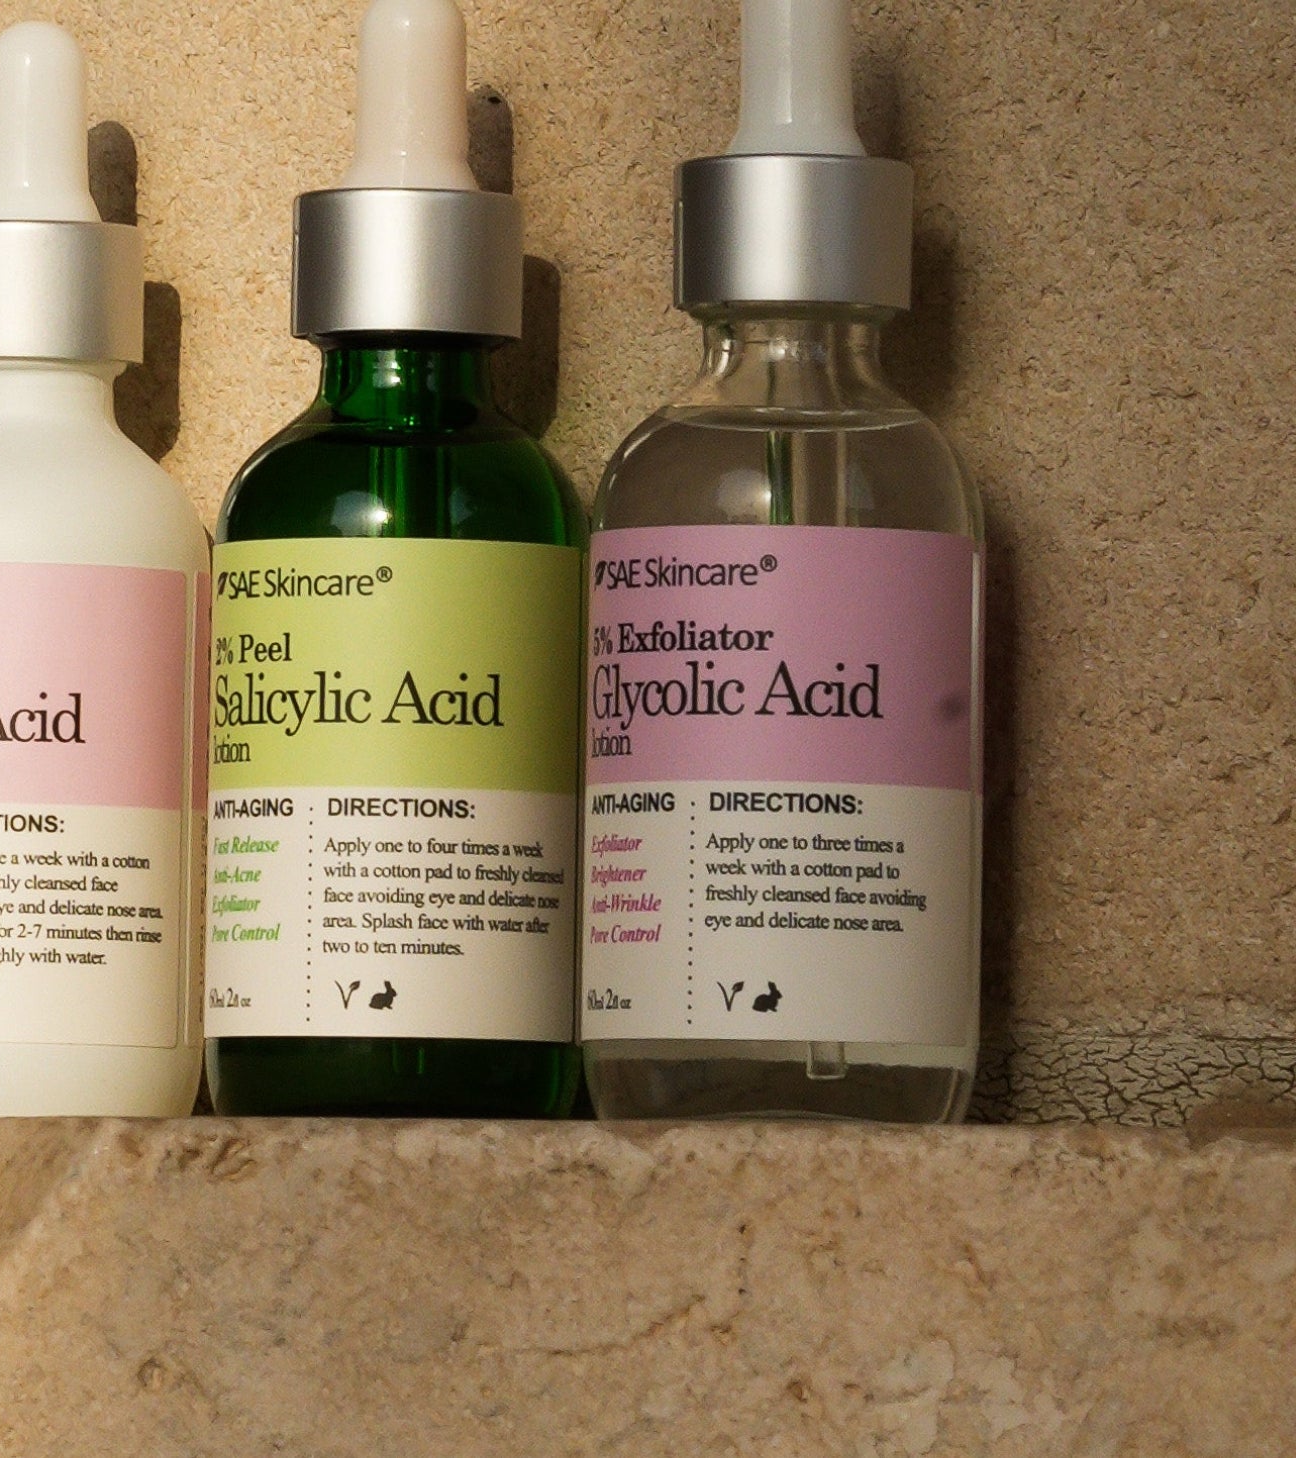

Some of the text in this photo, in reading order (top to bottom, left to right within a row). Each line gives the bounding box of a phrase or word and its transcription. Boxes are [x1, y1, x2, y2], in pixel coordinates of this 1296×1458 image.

[607, 558, 640, 589] SAE
[229, 570, 259, 599] SAE
[239, 633, 292, 663] Peel
[594, 620, 774, 656] 5% Exfoliator
[215, 671, 504, 736] Salicylic Acid
[593, 660, 883, 731] Glycolic Acid
[214, 798, 293, 820] ANTI-AGING
[328, 798, 475, 819] DIRECTIONS:
[592, 792, 675, 815] ANTI-AGING
[709, 792, 863, 814] DIRECTIONS:
[231, 835, 280, 854] Release
[324, 837, 372, 857] Apply
[375, 841, 404, 853] one
[408, 839, 422, 853] to
[427, 838, 458, 854] four
[462, 839, 500, 855] times
[502, 844, 511, 855] a
[706, 833, 904, 854] Apply one to three times a
[706, 859, 900, 882] week with a cotton pad to
[24, 875, 87, 891] cleansed
[91, 877, 119, 893] face
[324, 887, 354, 904] face
[358, 888, 424, 907] avoiding
[429, 892, 455, 909] eye
[459, 890, 485, 906] and
[489, 890, 536, 908] delicate
[19, 899, 45, 914] and
[50, 899, 104, 916] delicate
[107, 905, 136, 917] nose
[138, 906, 163, 919] area.
[232, 923, 280, 940] Control
[323, 916, 357, 928] area.
[363, 913, 413, 933] Splash
[418, 914, 449, 930] face
[454, 914, 484, 932] with
[488, 918, 524, 934] water
[705, 912, 904, 932] eye and delicate nose area.
[611, 924, 661, 943] Control
[30, 949, 62, 963] with
[66, 951, 106, 965] water.
[323, 940, 465, 956] two to ten minutes.
